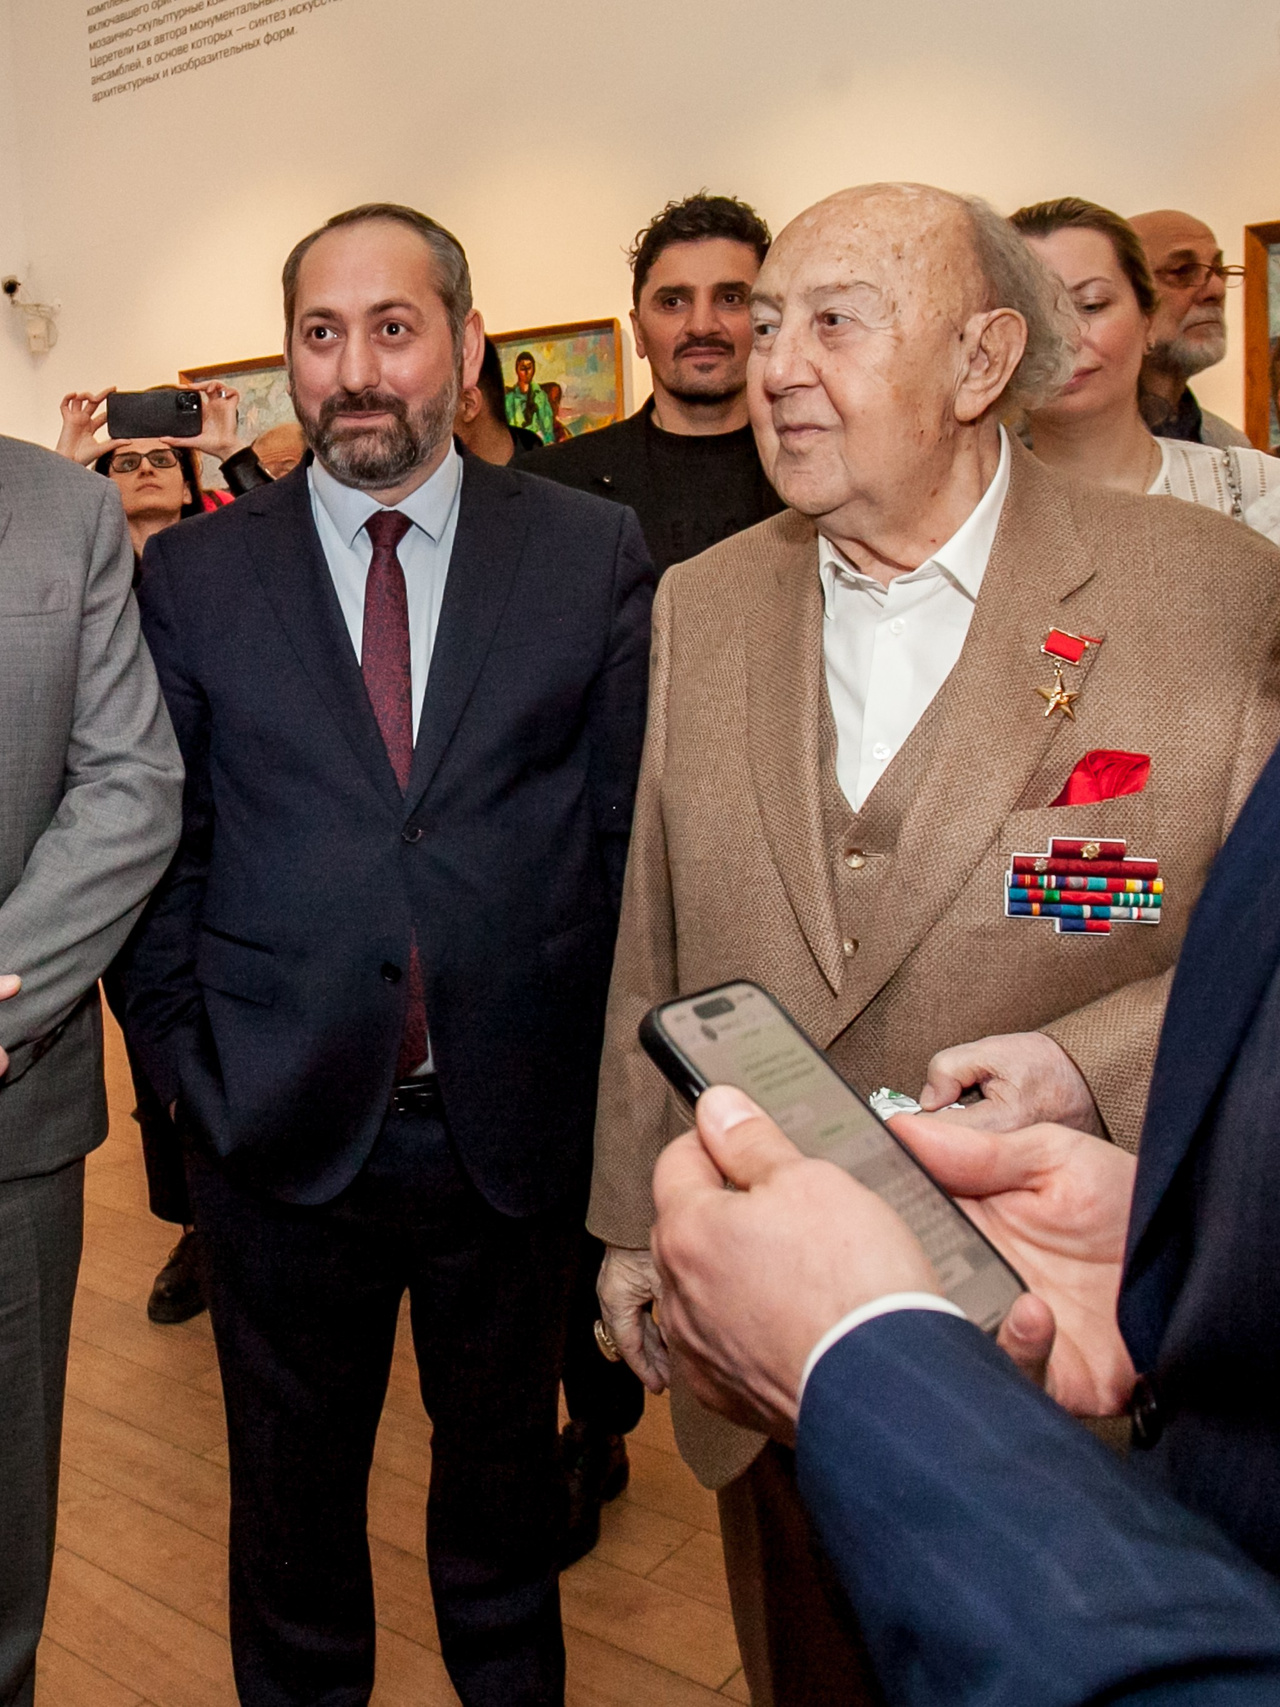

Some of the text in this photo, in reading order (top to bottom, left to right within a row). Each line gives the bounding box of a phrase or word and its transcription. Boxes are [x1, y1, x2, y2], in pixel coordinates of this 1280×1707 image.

[87, 0, 130, 16] компле
[88, 4, 149, 34] включавшего
[89, 1, 204, 51] мозаично-скульптурные
[90, 45, 134, 68] Церетели
[136, 39, 152, 51] как
[154, 26, 187, 45] автора
[146, 57, 152, 66] в
[154, 44, 188, 63] основе
[191, 29, 233, 50] которых
[249, 10, 286, 30] синтез
[92, 27, 297, 103] архитектурных и изобразительных форм.
